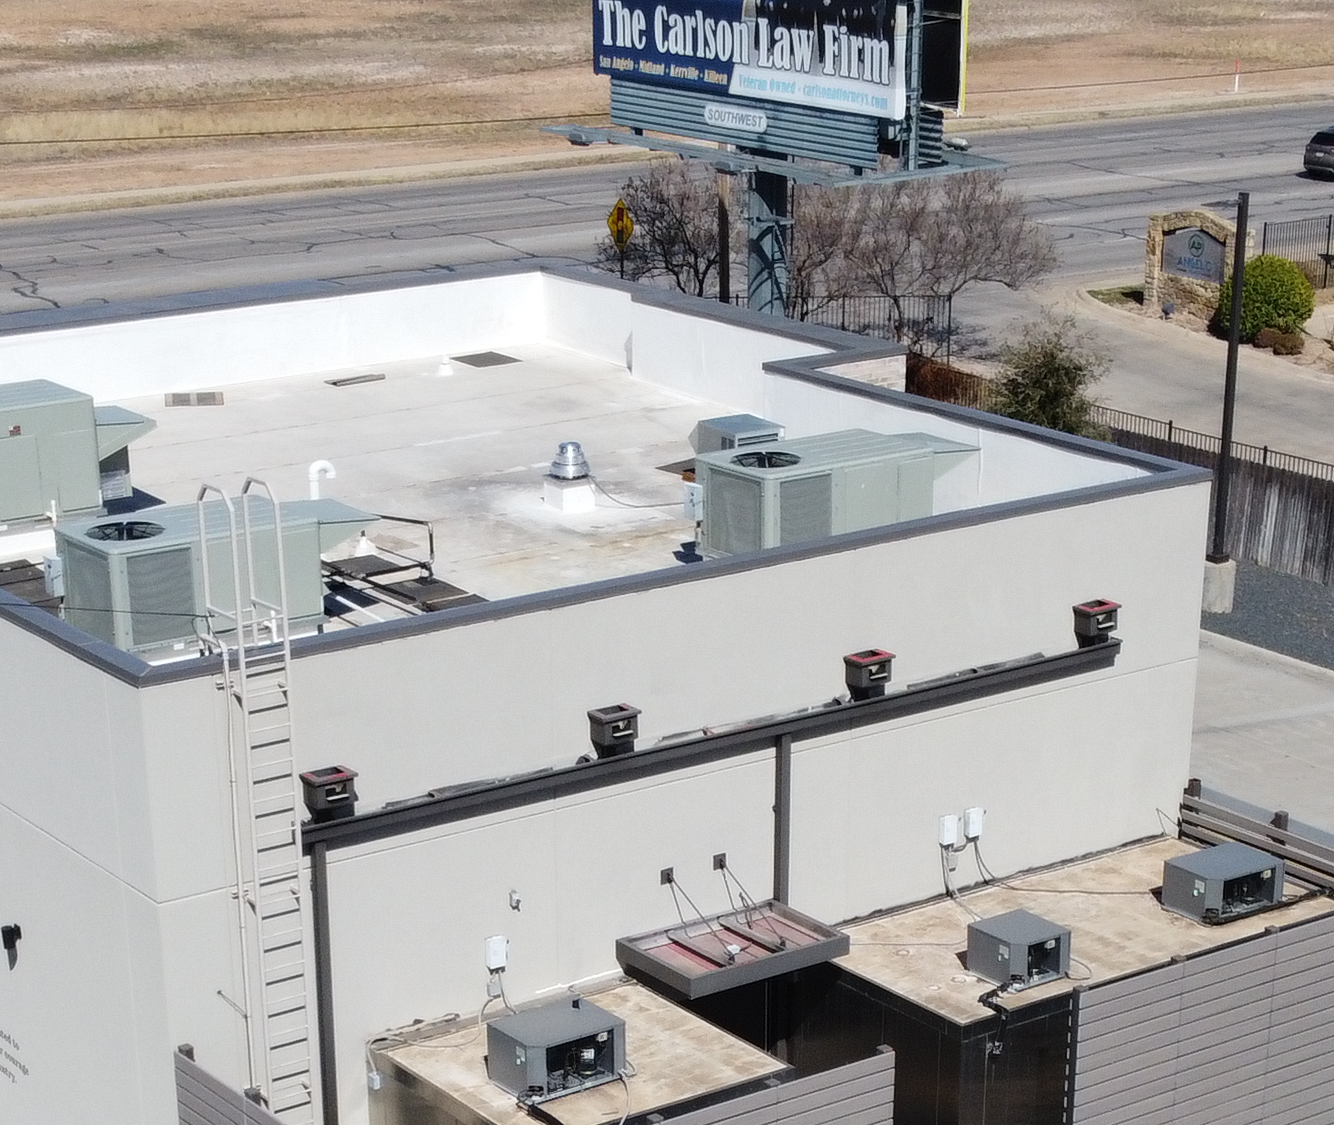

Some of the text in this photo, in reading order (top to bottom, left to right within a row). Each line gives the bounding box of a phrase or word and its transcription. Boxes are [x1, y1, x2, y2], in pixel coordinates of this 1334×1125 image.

[599, 0, 890, 85] The Carlson Law Firm
[599, 55, 728, 85] San Angelo Midland Kerrville Killeen
[739, 74, 888, 110] Veteran Owned carlsonattorneys.com
[708, 109, 763, 127] SOUTHWEST
[12, 1039, 20, 1051] to
[4, 1051, 29, 1076] courage
